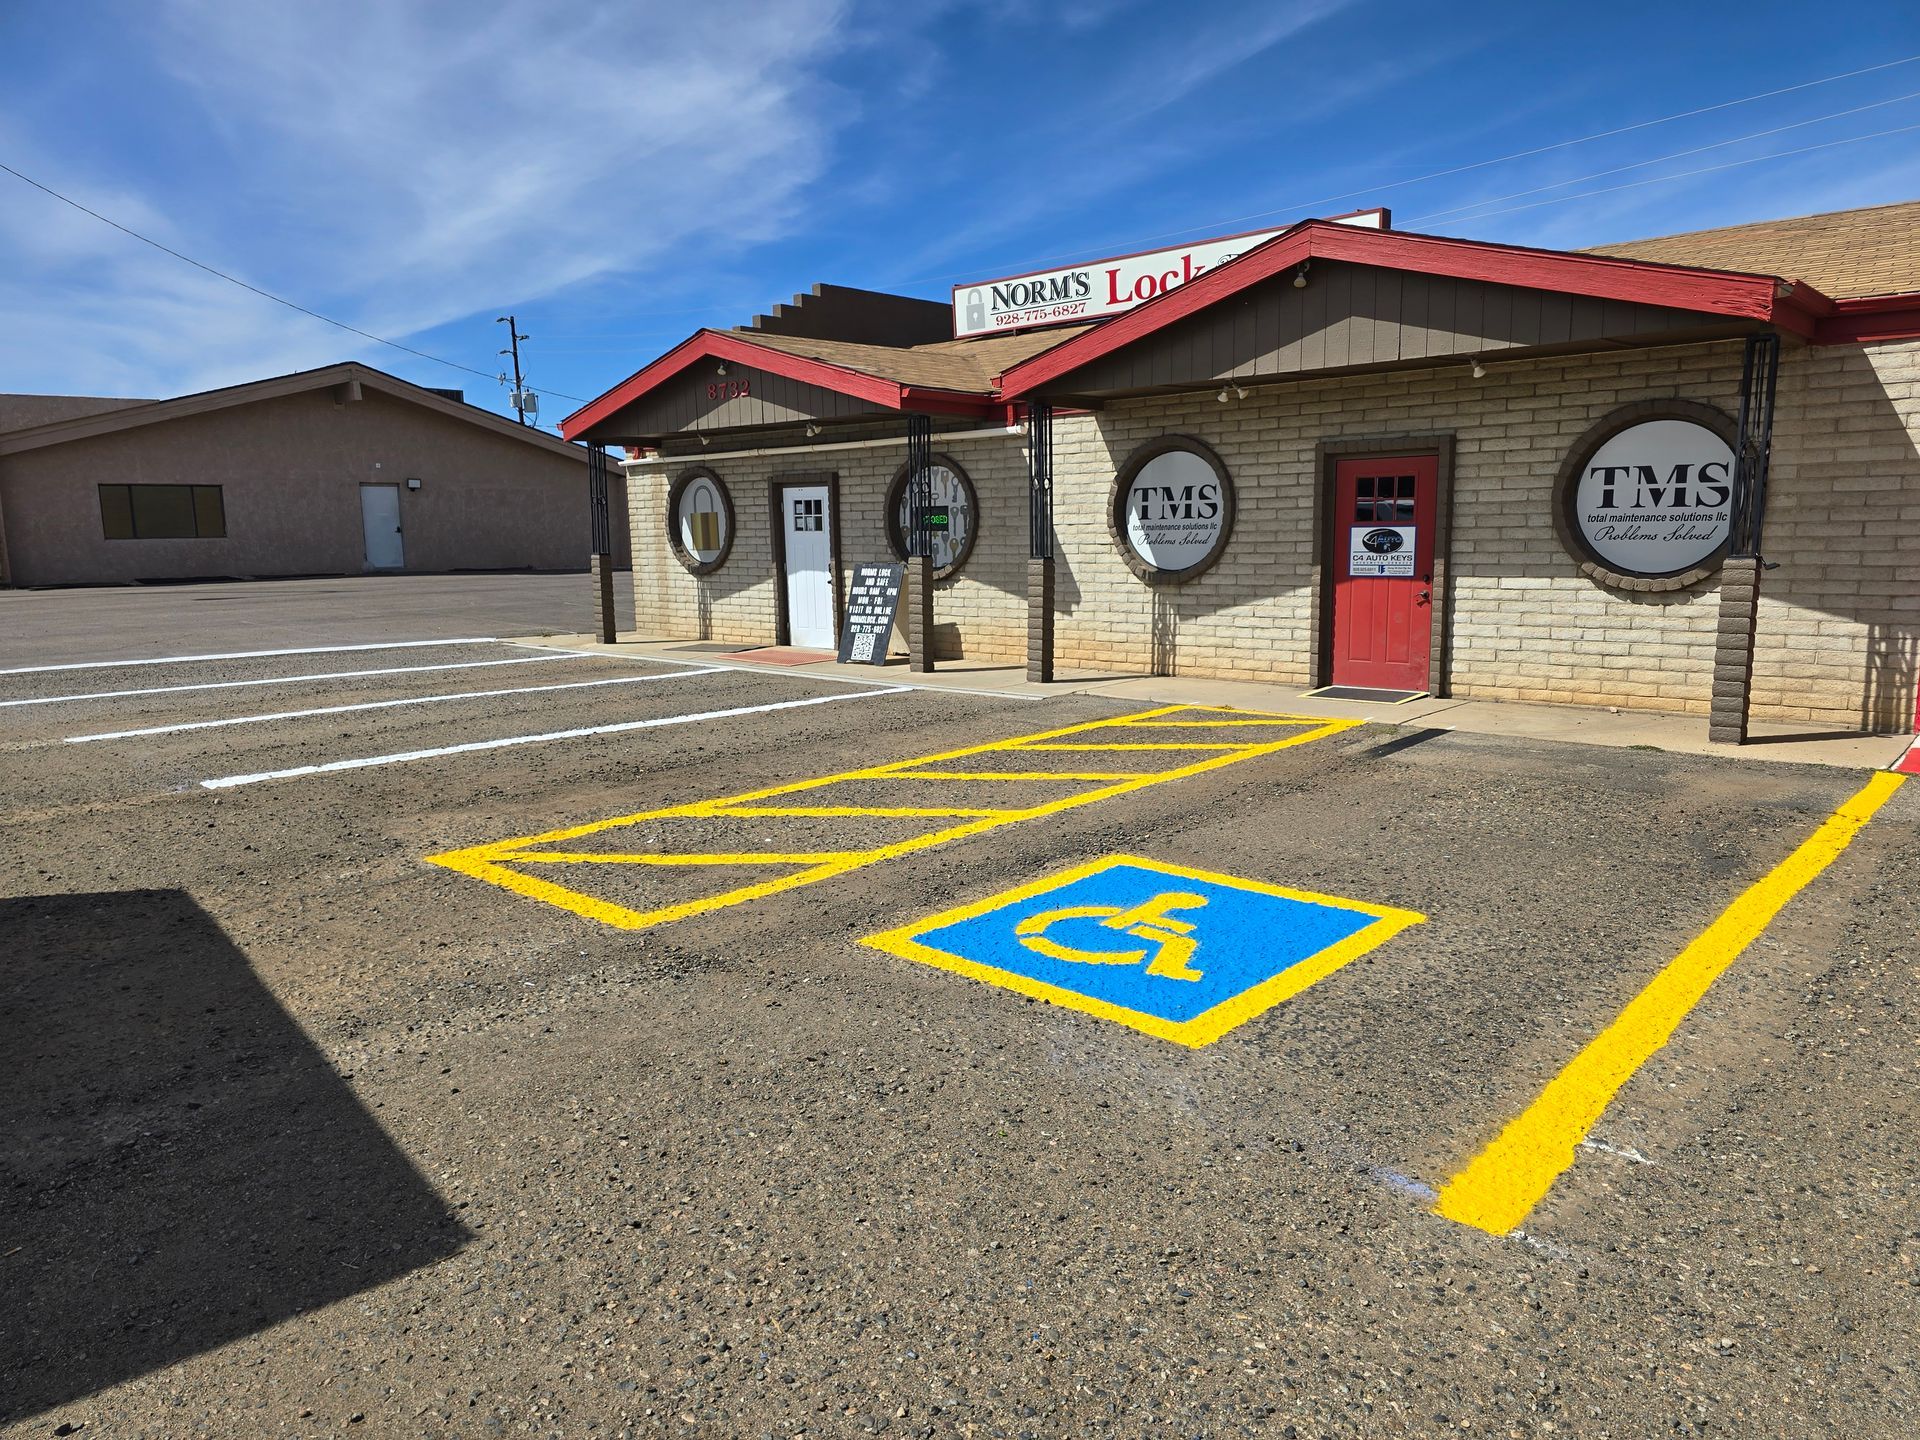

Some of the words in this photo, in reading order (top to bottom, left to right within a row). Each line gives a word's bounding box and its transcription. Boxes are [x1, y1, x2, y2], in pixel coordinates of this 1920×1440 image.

[991, 271, 1091, 311] NORM'S
[1105, 254, 1206, 305] Lock
[995, 302, 1087, 326] 928-775-6827
[707, 379, 750, 400] 8732
[1590, 461, 1731, 509] TMS
[1133, 484, 1218, 520] TMS
[1587, 513, 1607, 523] total
[1609, 513, 1667, 523] maintenance
[1669, 512, 1714, 522] solutions
[1716, 512, 1728, 521] llc
[1133, 523, 1145, 531] total
[1146, 523, 1180, 531] maintenance
[1182, 522, 1209, 531] solutions
[1210, 522, 1218, 530] llc
[1137, 532, 1176, 545] Problems
[1179, 531, 1213, 545] Solved
[1594, 525, 1658, 542] Problems
[1663, 523, 1719, 542] Solved
[861, 568, 878, 576] NORMS
[878, 568, 892, 577] LOCK
[865, 578, 875, 586] AND
[876, 578, 889, 586] SAFE
[852, 587, 868, 595] HOURS
[886, 587, 898, 596] 4PM
[857, 596, 870, 604] MON
[873, 597, 883, 605] FRI
[849, 606, 864, 614] VISIT
[865, 606, 873, 614] US
[874, 606, 892, 615] ONLINE
[850, 615, 889, 625] NORMSLOCK.COM
